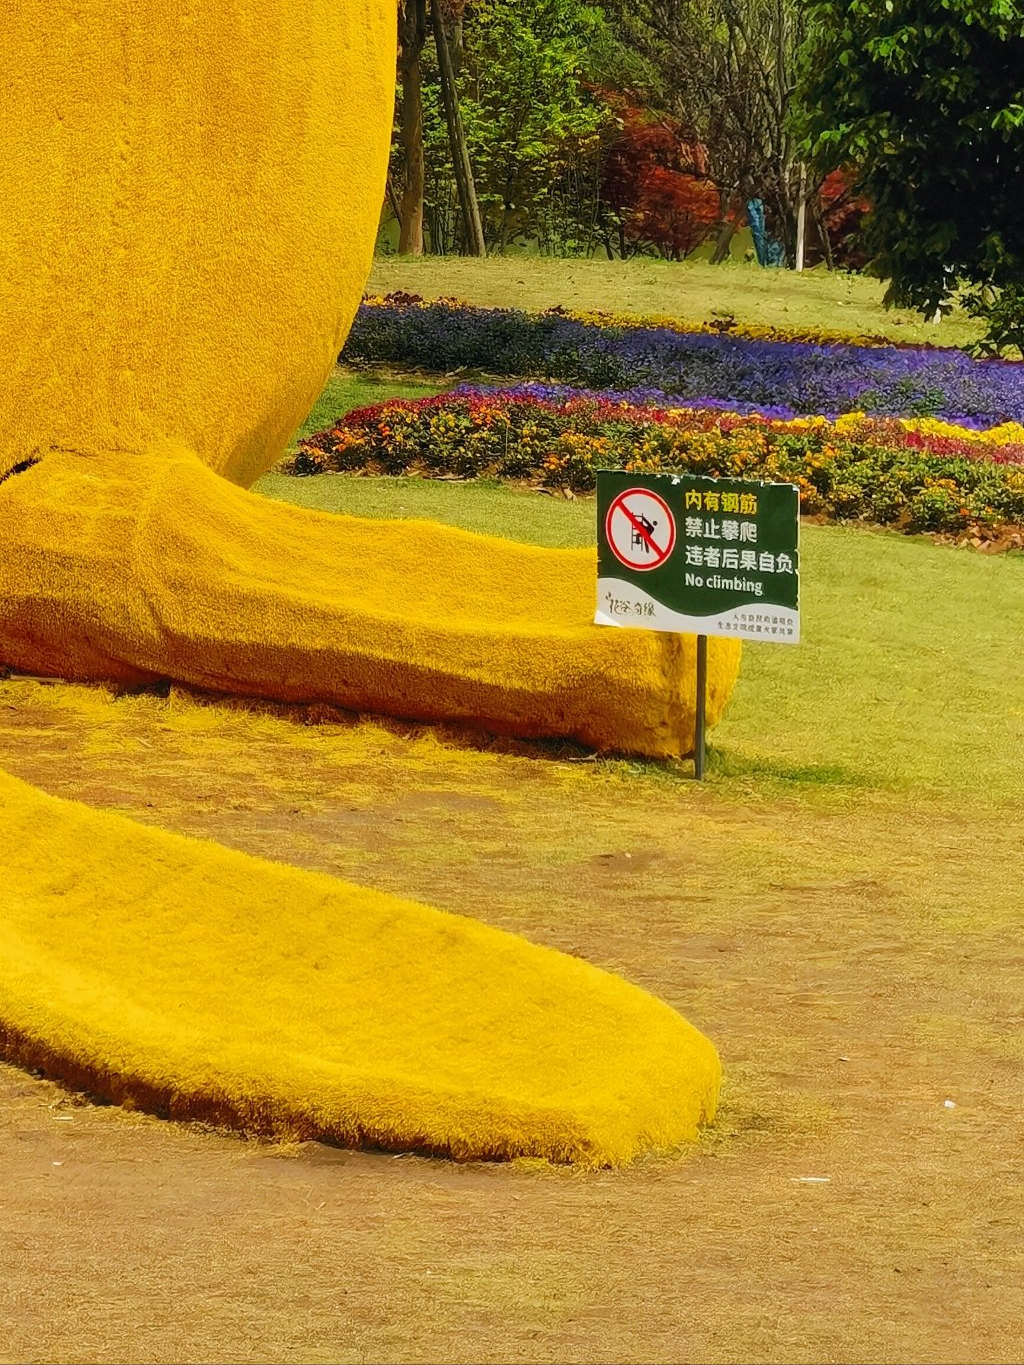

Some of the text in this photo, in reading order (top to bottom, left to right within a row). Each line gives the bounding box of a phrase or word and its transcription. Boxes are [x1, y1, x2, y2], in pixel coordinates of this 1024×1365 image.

[685, 489, 758, 515] 内有钢筋
[685, 516, 758, 543] 禁止攀爬
[685, 545, 794, 574] 违者后果自负
[685, 572, 764, 597] No climbing
